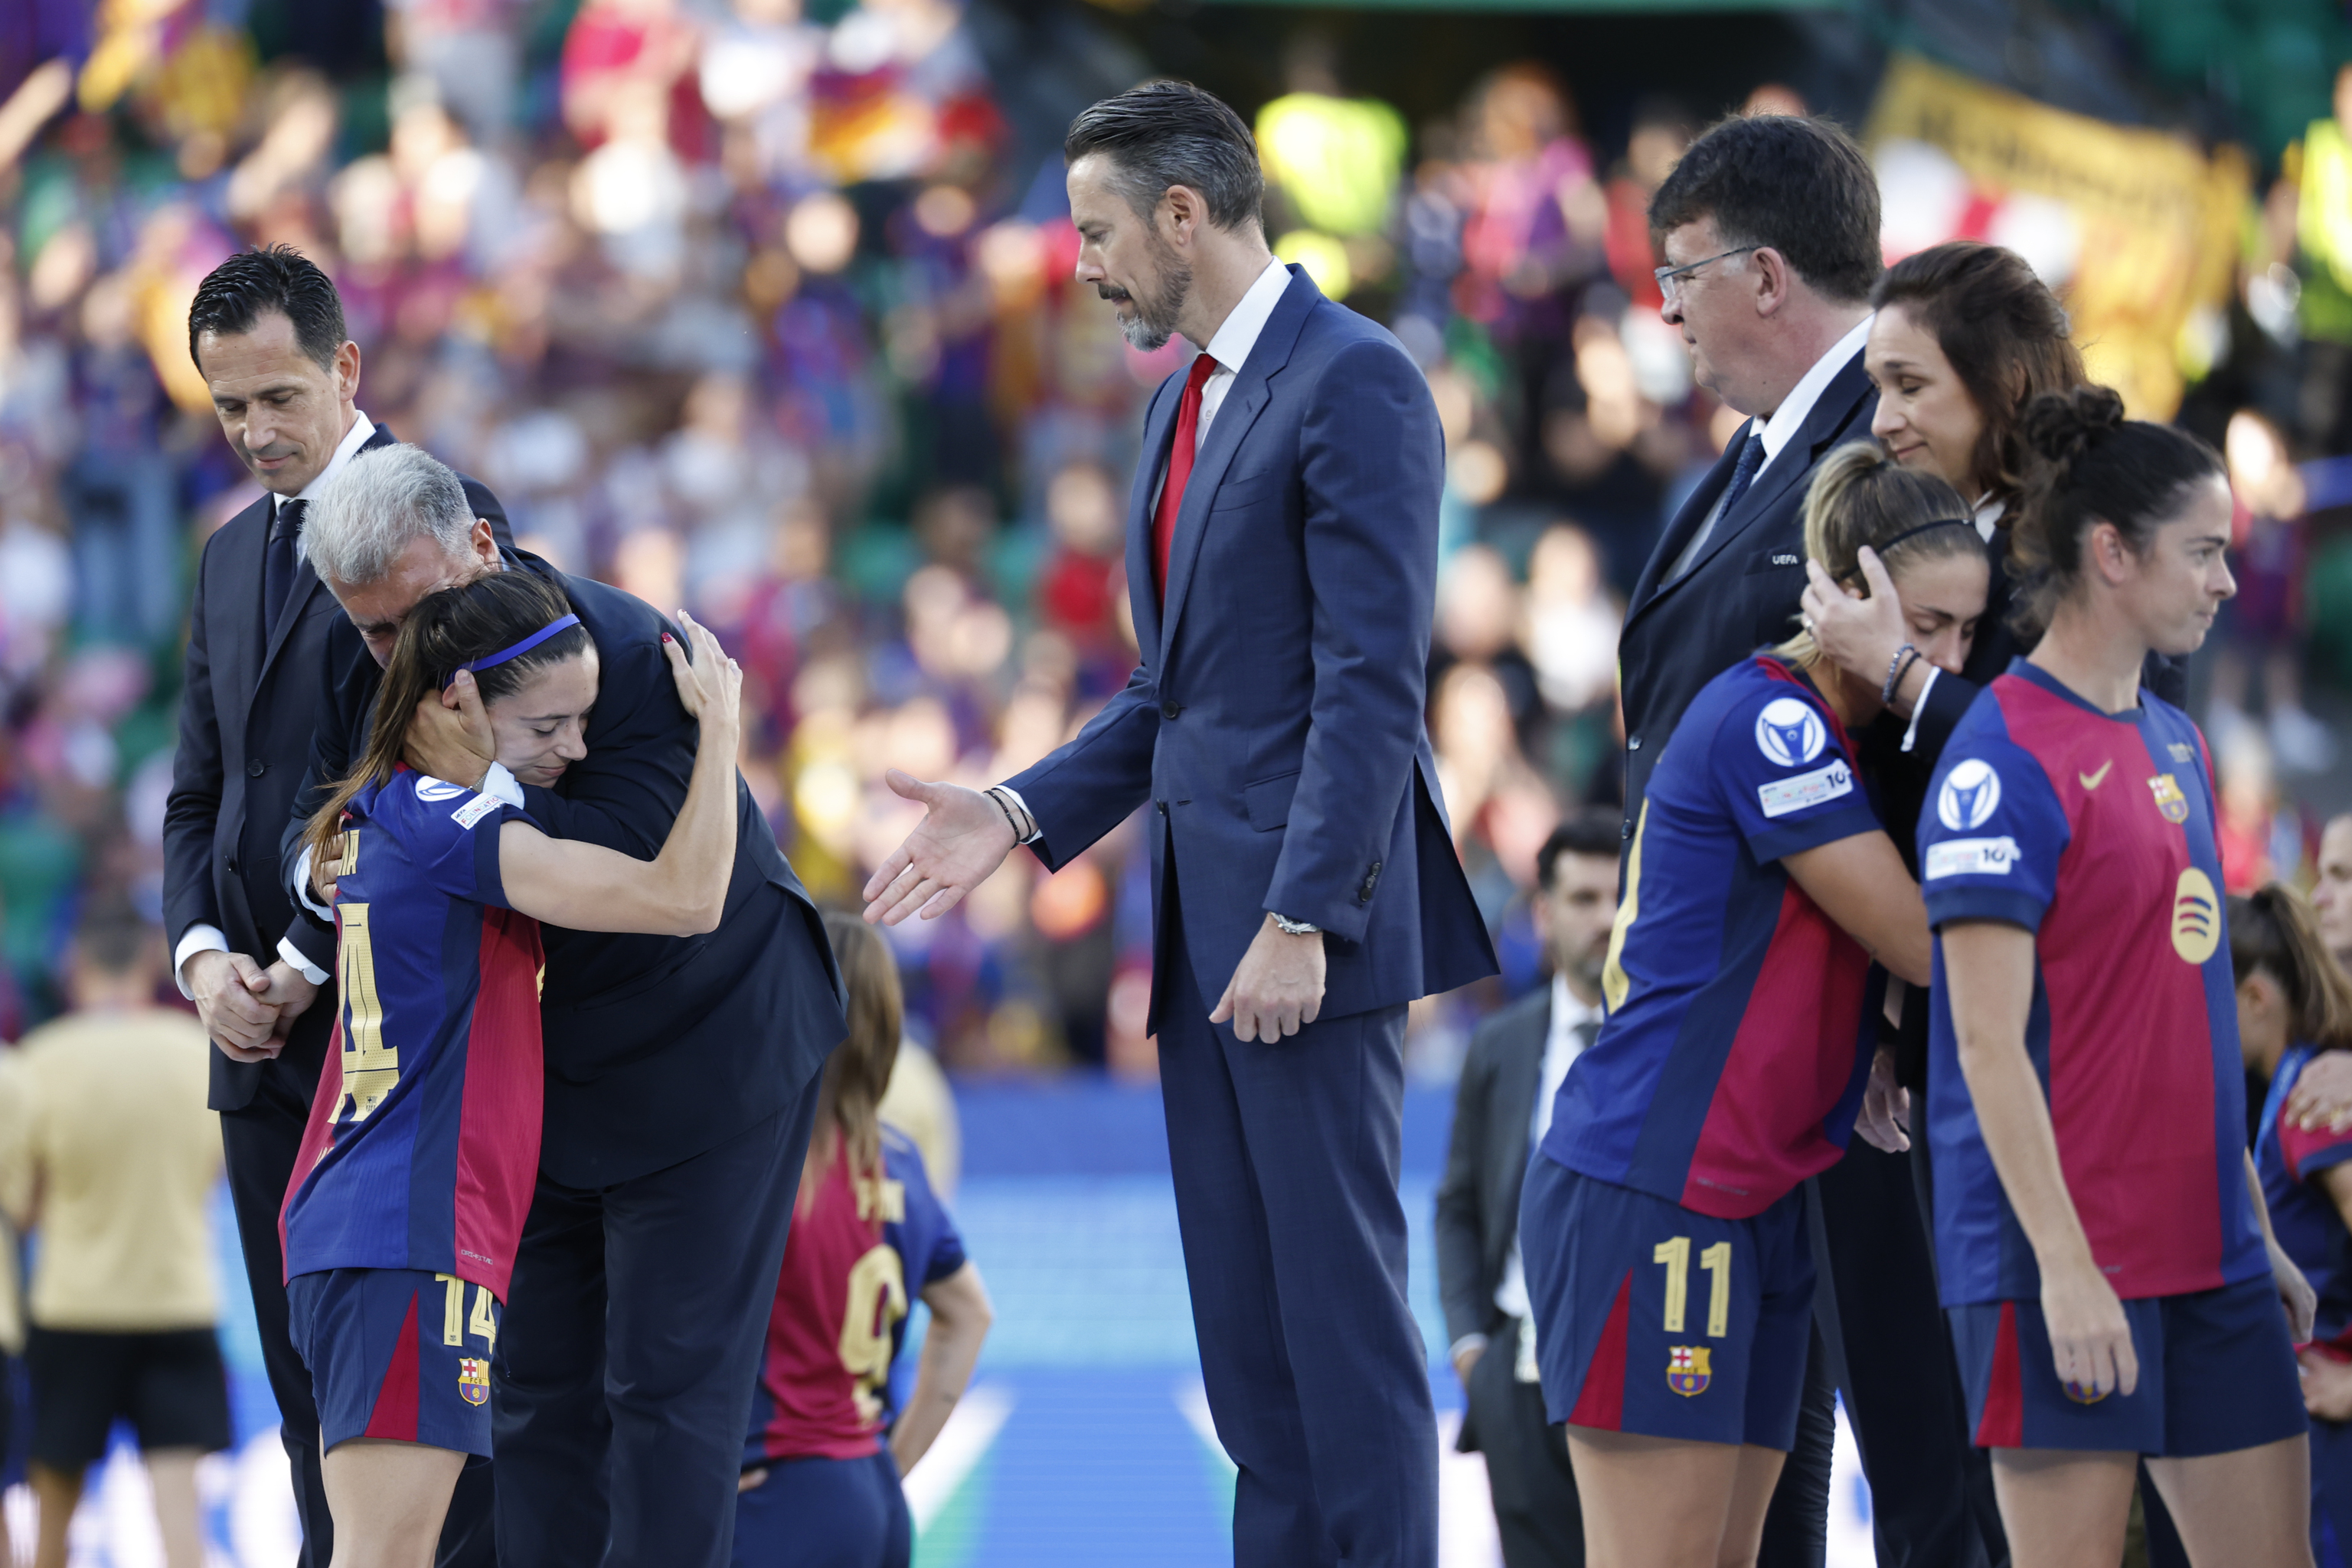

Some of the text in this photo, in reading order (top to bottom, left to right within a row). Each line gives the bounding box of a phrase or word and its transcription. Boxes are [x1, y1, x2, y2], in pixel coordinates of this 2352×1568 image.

[1772, 554, 1798, 565] UEFA
[1826, 770, 1846, 789] 10
[461, 796, 499, 825] FOUNDATIO
[1653, 1236, 1731, 1338] 11
[435, 1272, 496, 1355] 14
